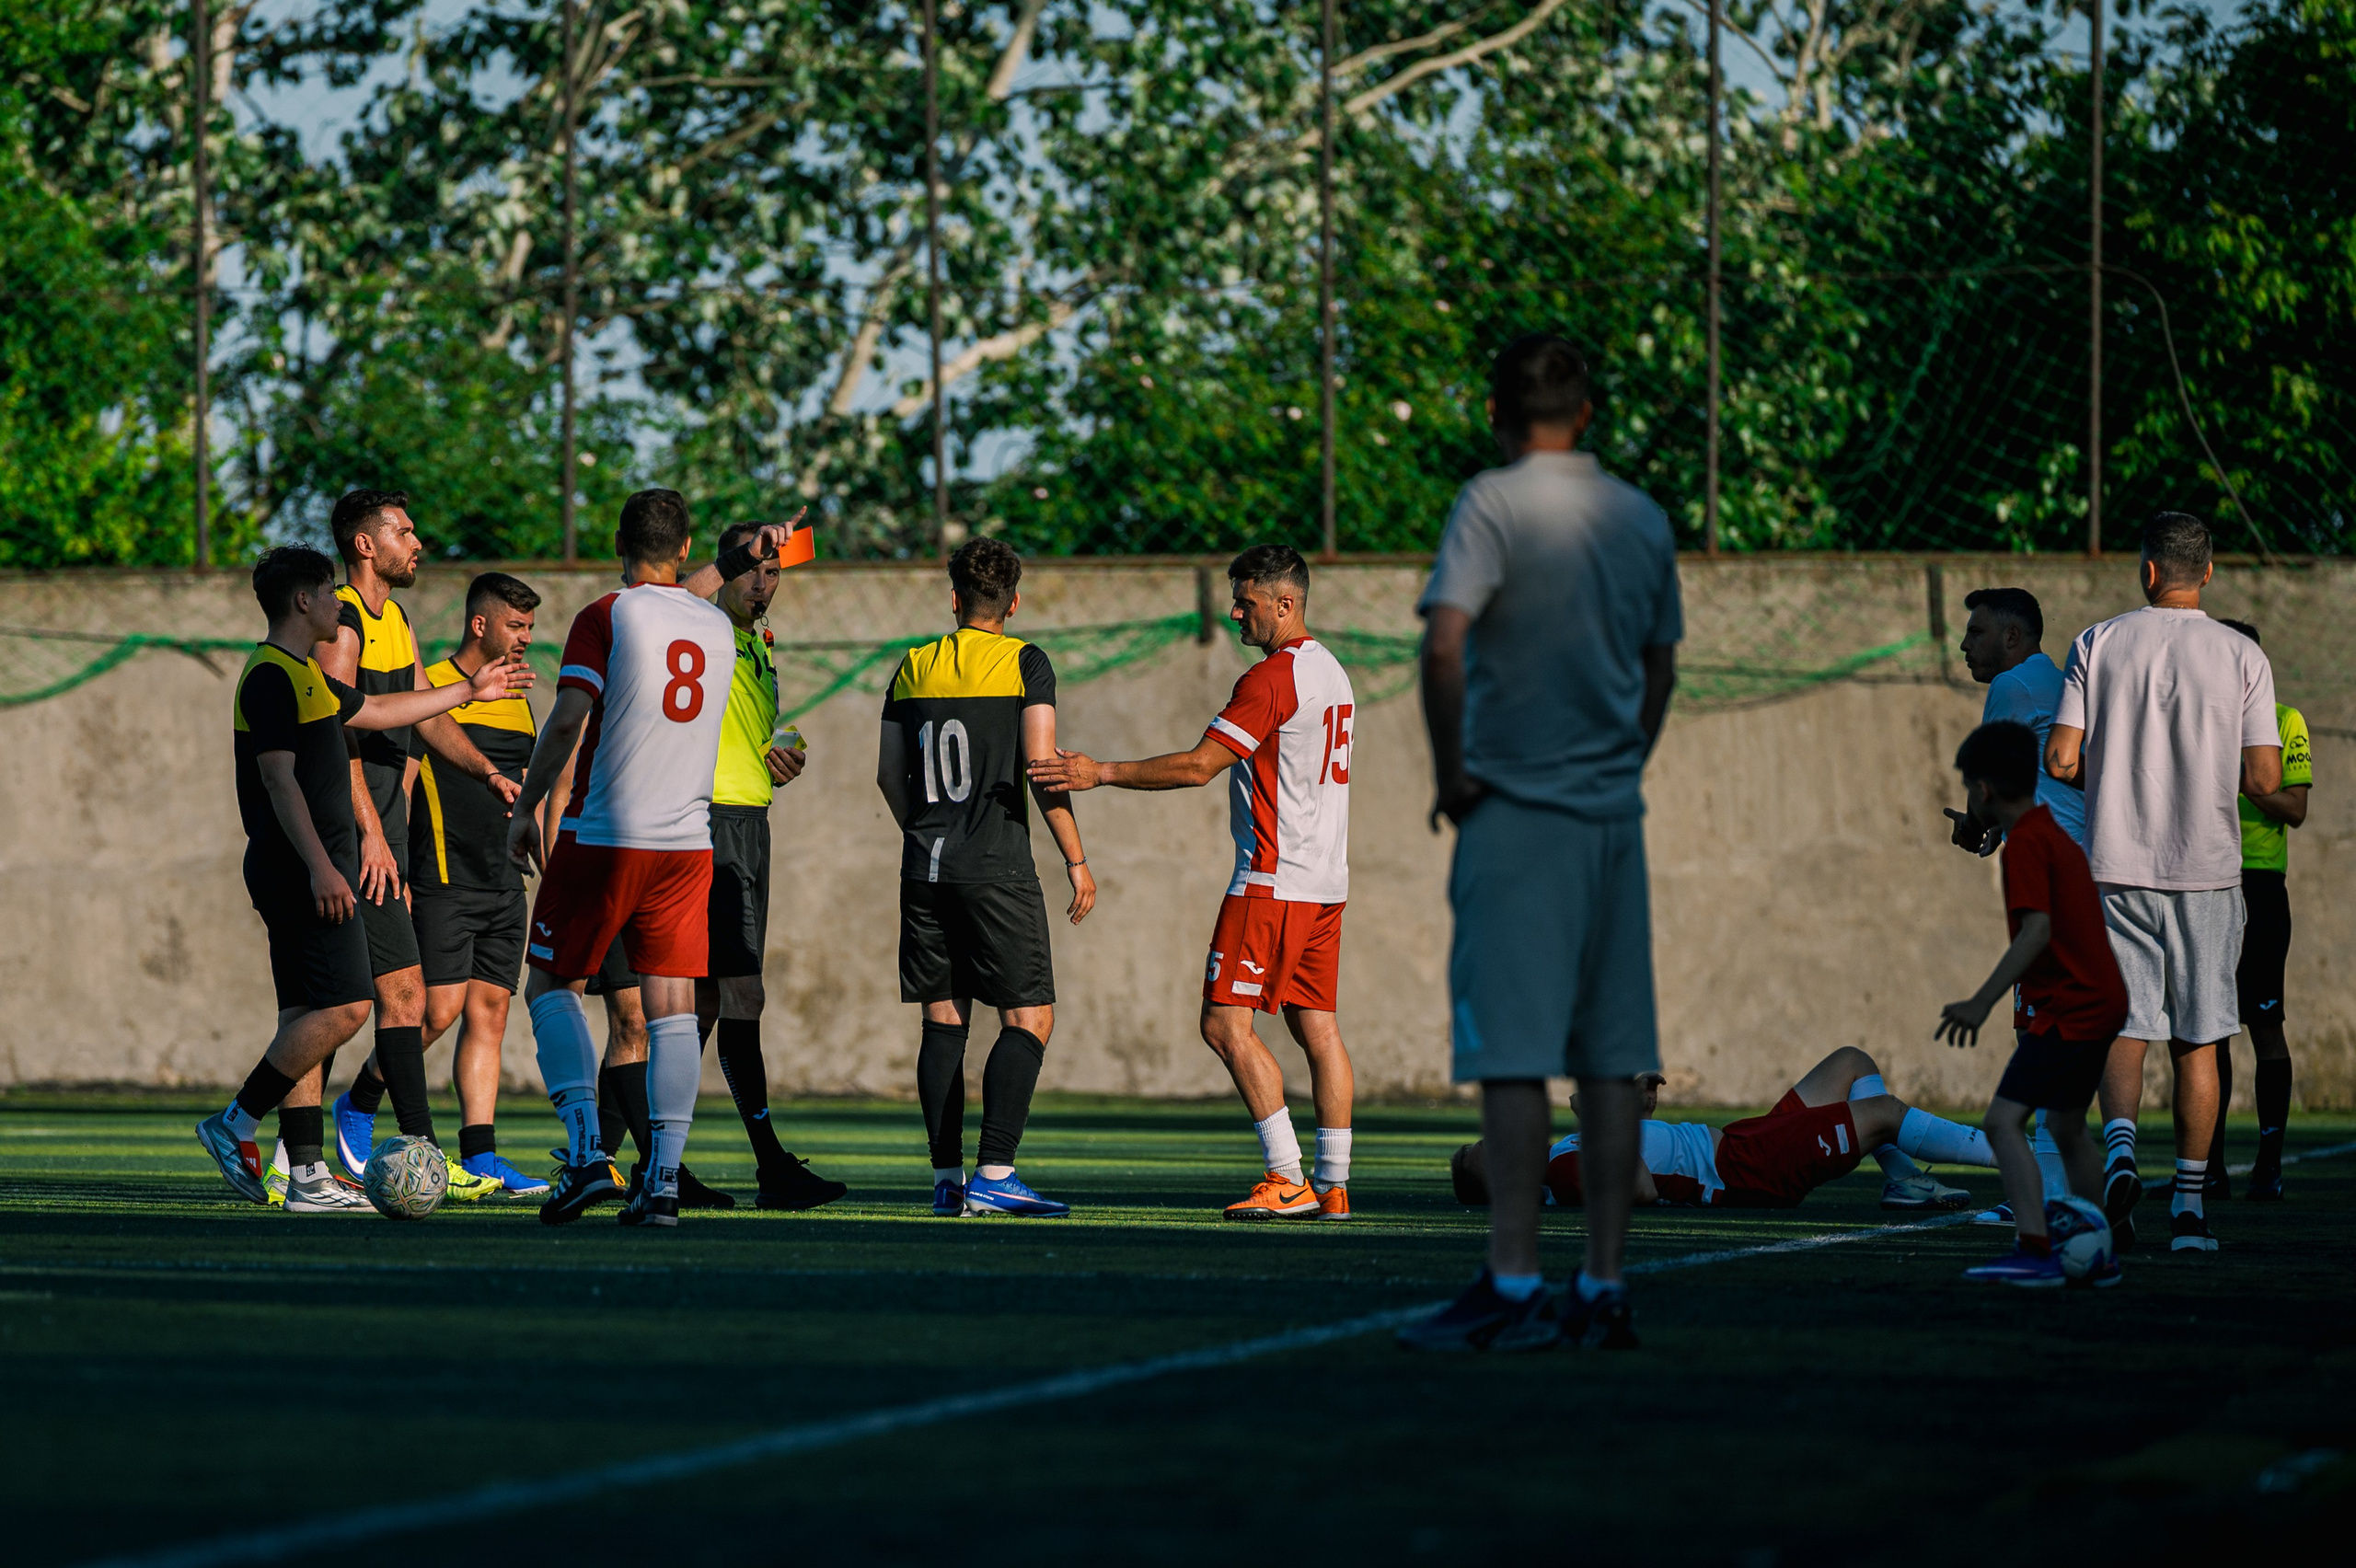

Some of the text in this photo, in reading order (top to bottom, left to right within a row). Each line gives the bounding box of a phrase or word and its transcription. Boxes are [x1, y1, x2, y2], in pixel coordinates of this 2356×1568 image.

[662, 639, 706, 723] 8
[918, 719, 972, 803] 10
[1318, 703, 1354, 785] 15
